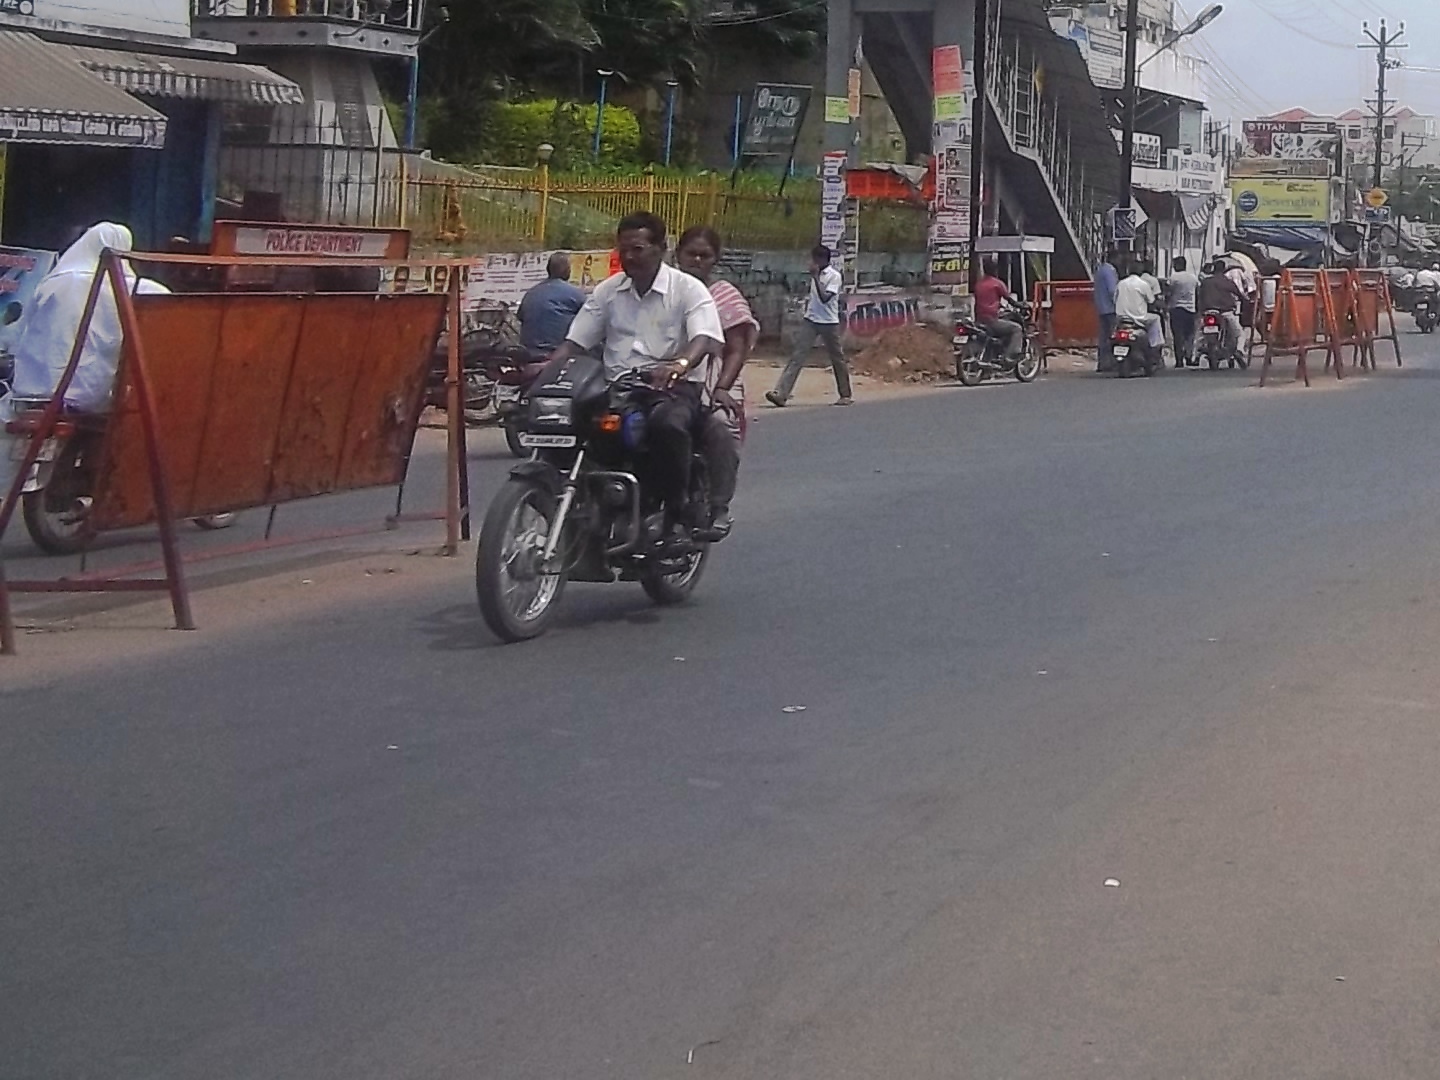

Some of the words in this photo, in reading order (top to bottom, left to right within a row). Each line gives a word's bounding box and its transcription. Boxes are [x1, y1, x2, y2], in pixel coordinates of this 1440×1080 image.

[1255, 122, 1287, 132] TITAN
[265, 229, 301, 252] POLICE
[302, 231, 364, 254] DEPARTMENT
